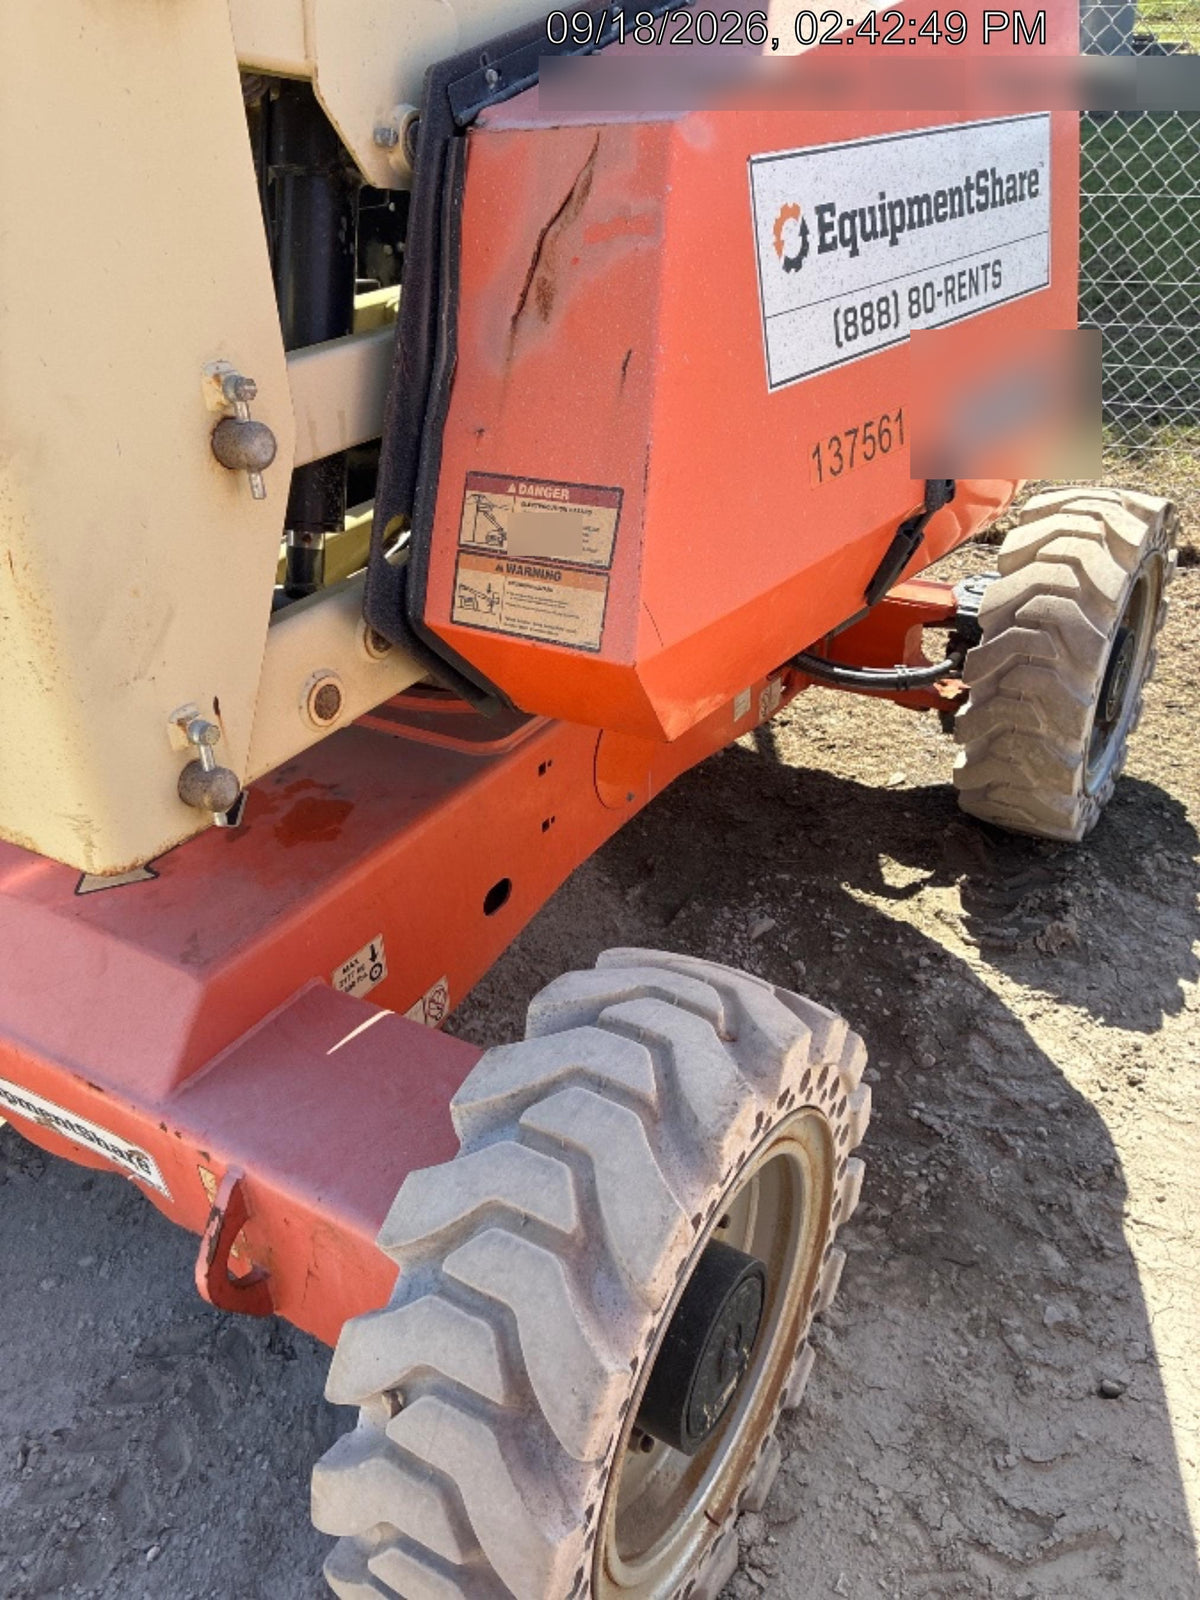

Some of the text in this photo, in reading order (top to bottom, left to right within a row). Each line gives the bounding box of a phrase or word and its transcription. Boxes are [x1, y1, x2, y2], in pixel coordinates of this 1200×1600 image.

[814, 167, 1040, 258] EquipmentShare
[833, 259, 1003, 348] (888) 80-RENTS
[812, 407, 904, 482] 137561
[518, 484, 570, 500] DANGER
[506, 563, 562, 582] WARNING
